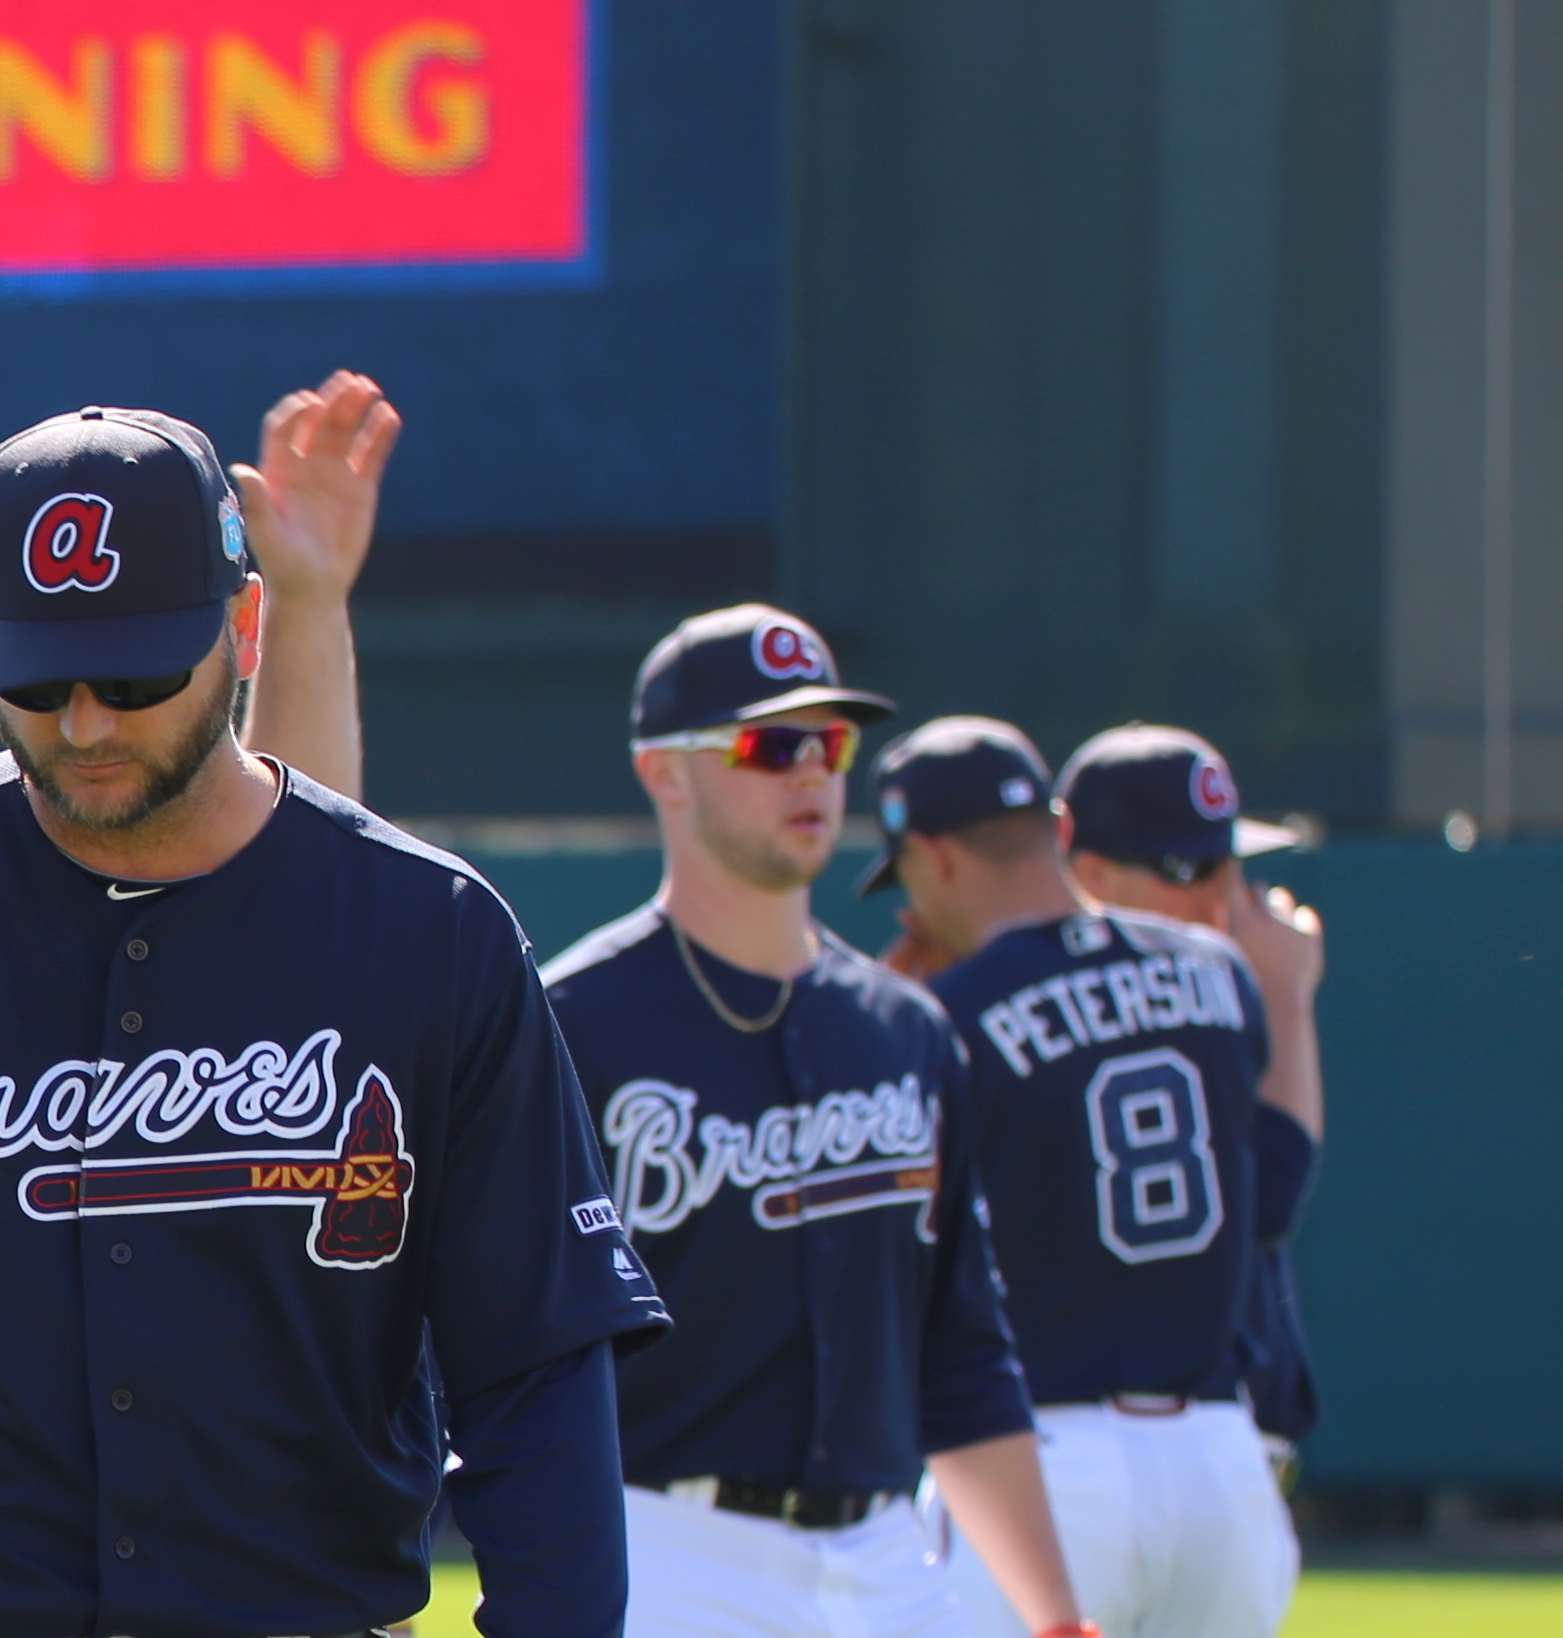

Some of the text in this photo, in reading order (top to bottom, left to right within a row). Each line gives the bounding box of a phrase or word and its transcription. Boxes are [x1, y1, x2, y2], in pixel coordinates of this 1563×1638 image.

[22, 492, 121, 594] a
[979, 953, 1244, 1078] PETERSON
[604, 1073, 935, 1245] Braves
[1084, 1048, 1224, 1264] 8
